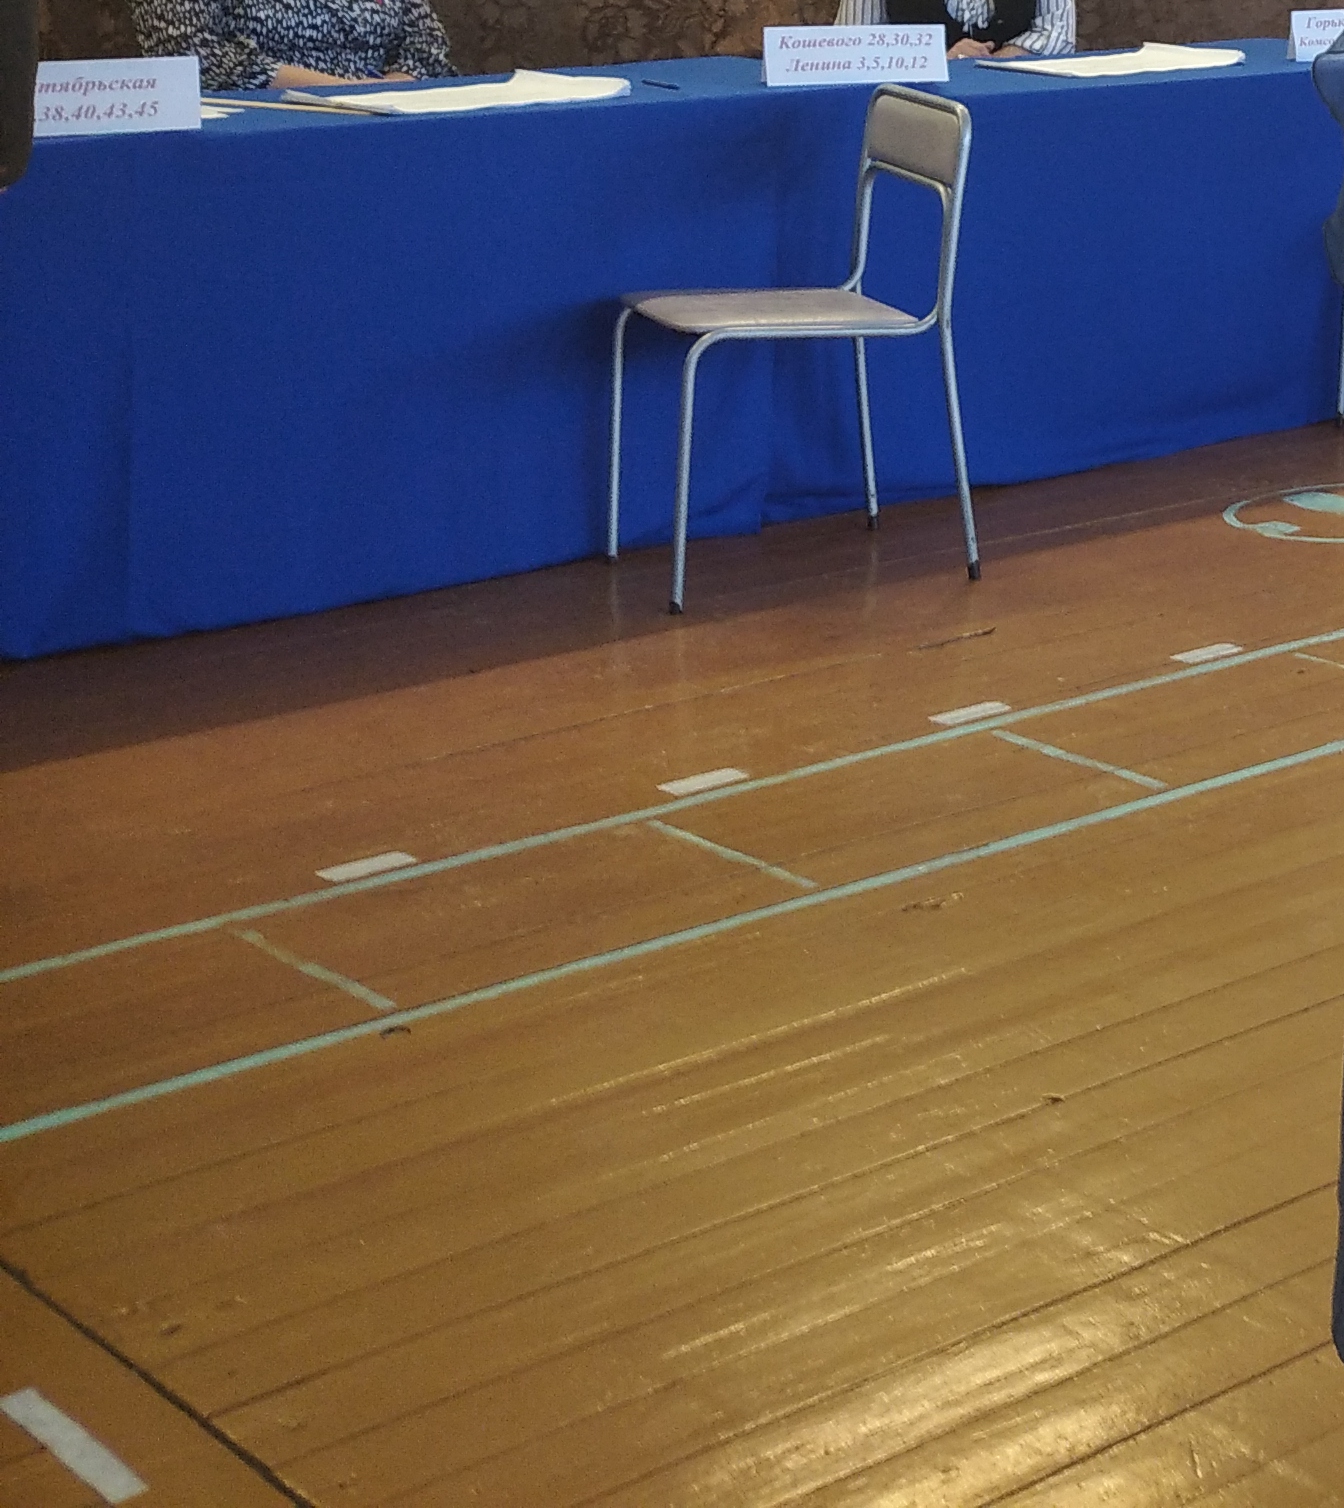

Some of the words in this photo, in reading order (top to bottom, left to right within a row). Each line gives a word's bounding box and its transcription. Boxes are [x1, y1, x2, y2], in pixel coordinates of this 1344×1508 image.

[778, 34, 863, 50] Кошевого
[867, 32, 933, 48] 28,30,32
[1299, 36, 1335, 48] Комсо
[785, 57, 852, 73] Ленина
[856, 55, 928, 72] 3,5,10,12
[37, 76, 158, 97] тябрьская
